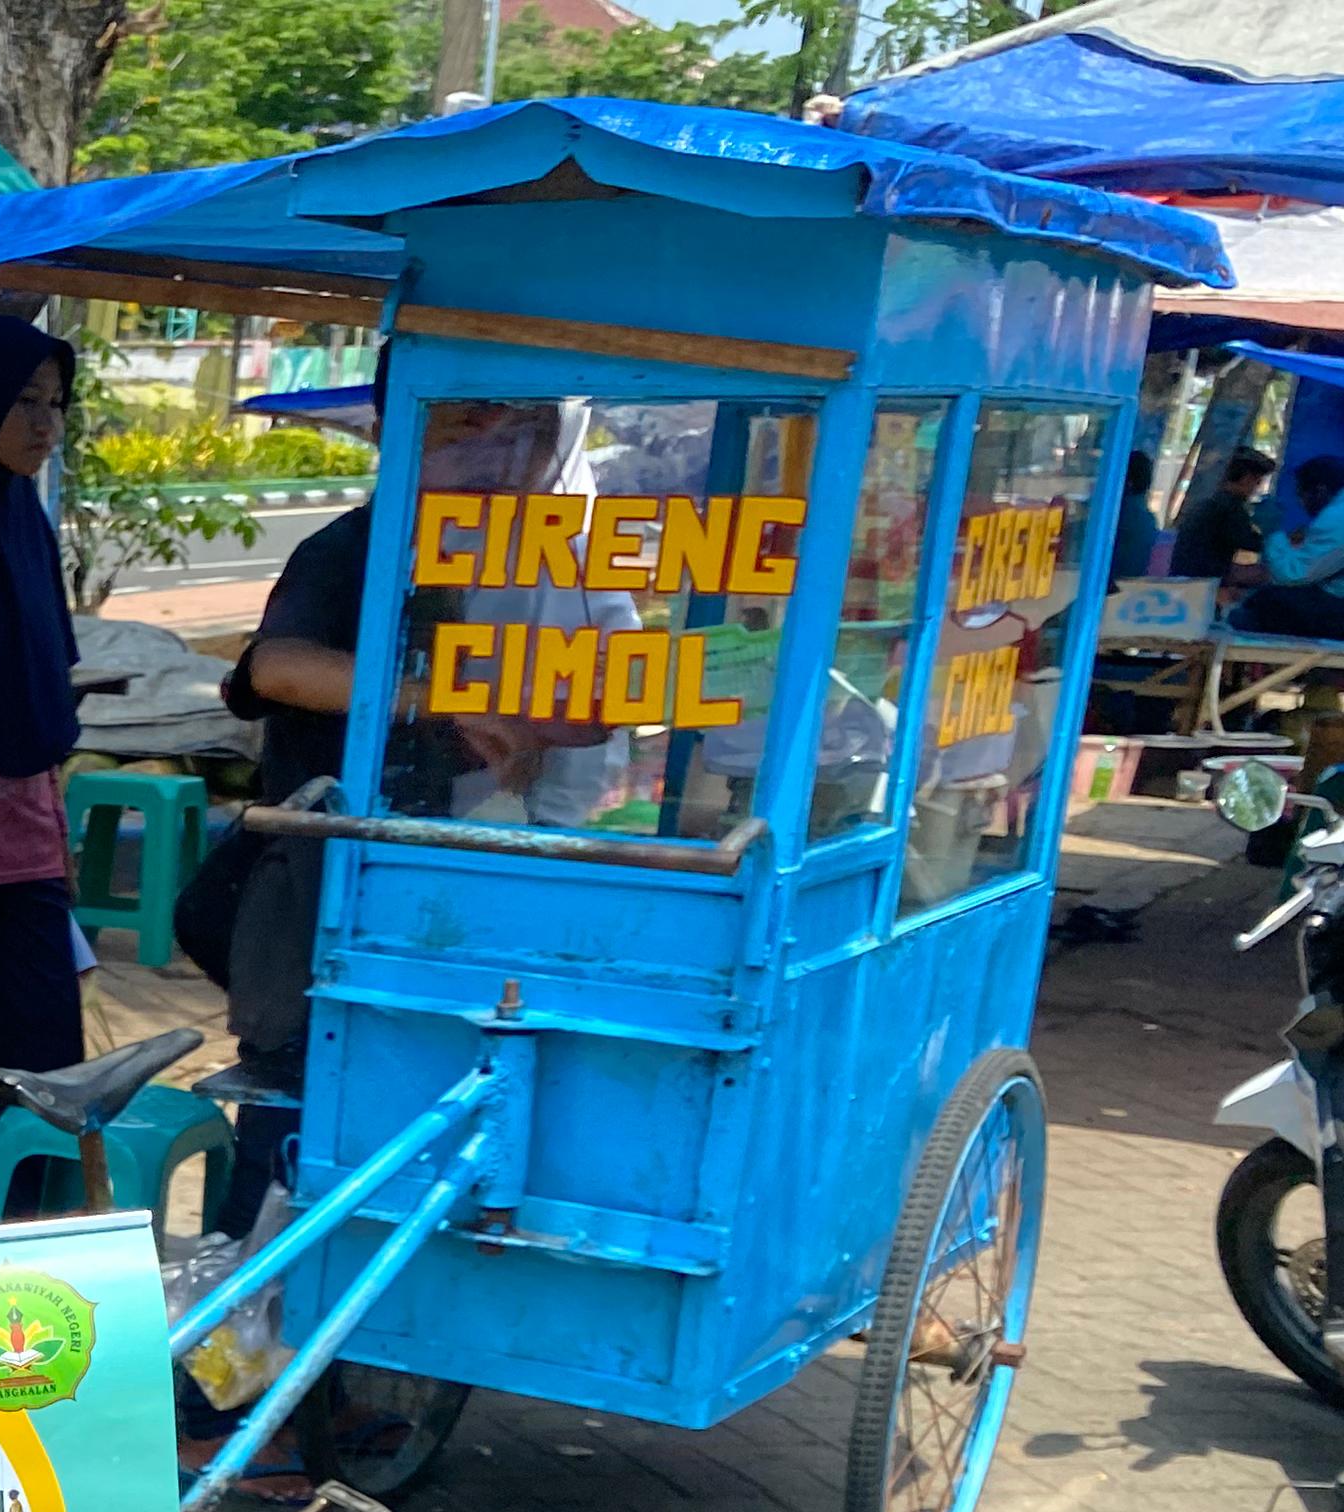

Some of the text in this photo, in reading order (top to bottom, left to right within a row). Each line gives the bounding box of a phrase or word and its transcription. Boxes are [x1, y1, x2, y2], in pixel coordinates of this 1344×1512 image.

[414, 492, 808, 595] CIRENG
[956, 507, 1064, 612] CIRENG
[428, 623, 741, 728] CIMOL
[938, 646, 1020, 747] CIMOL
